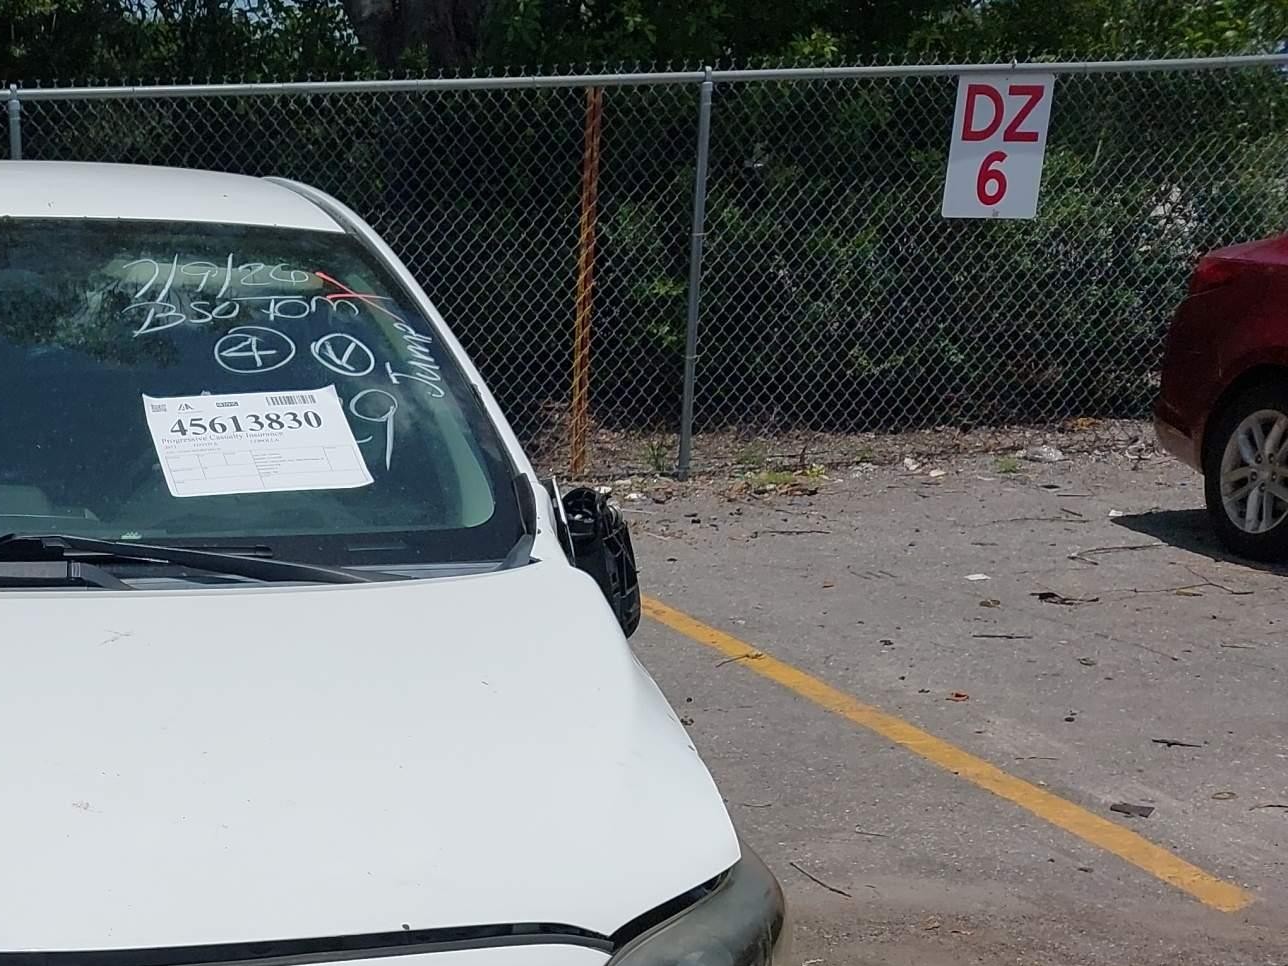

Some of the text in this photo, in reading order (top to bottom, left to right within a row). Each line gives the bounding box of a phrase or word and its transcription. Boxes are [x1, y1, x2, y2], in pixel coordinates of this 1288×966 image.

[961, 84, 1045, 142] DZ
[976, 150, 1008, 206] 6
[170, 410, 323, 436] 45613830
